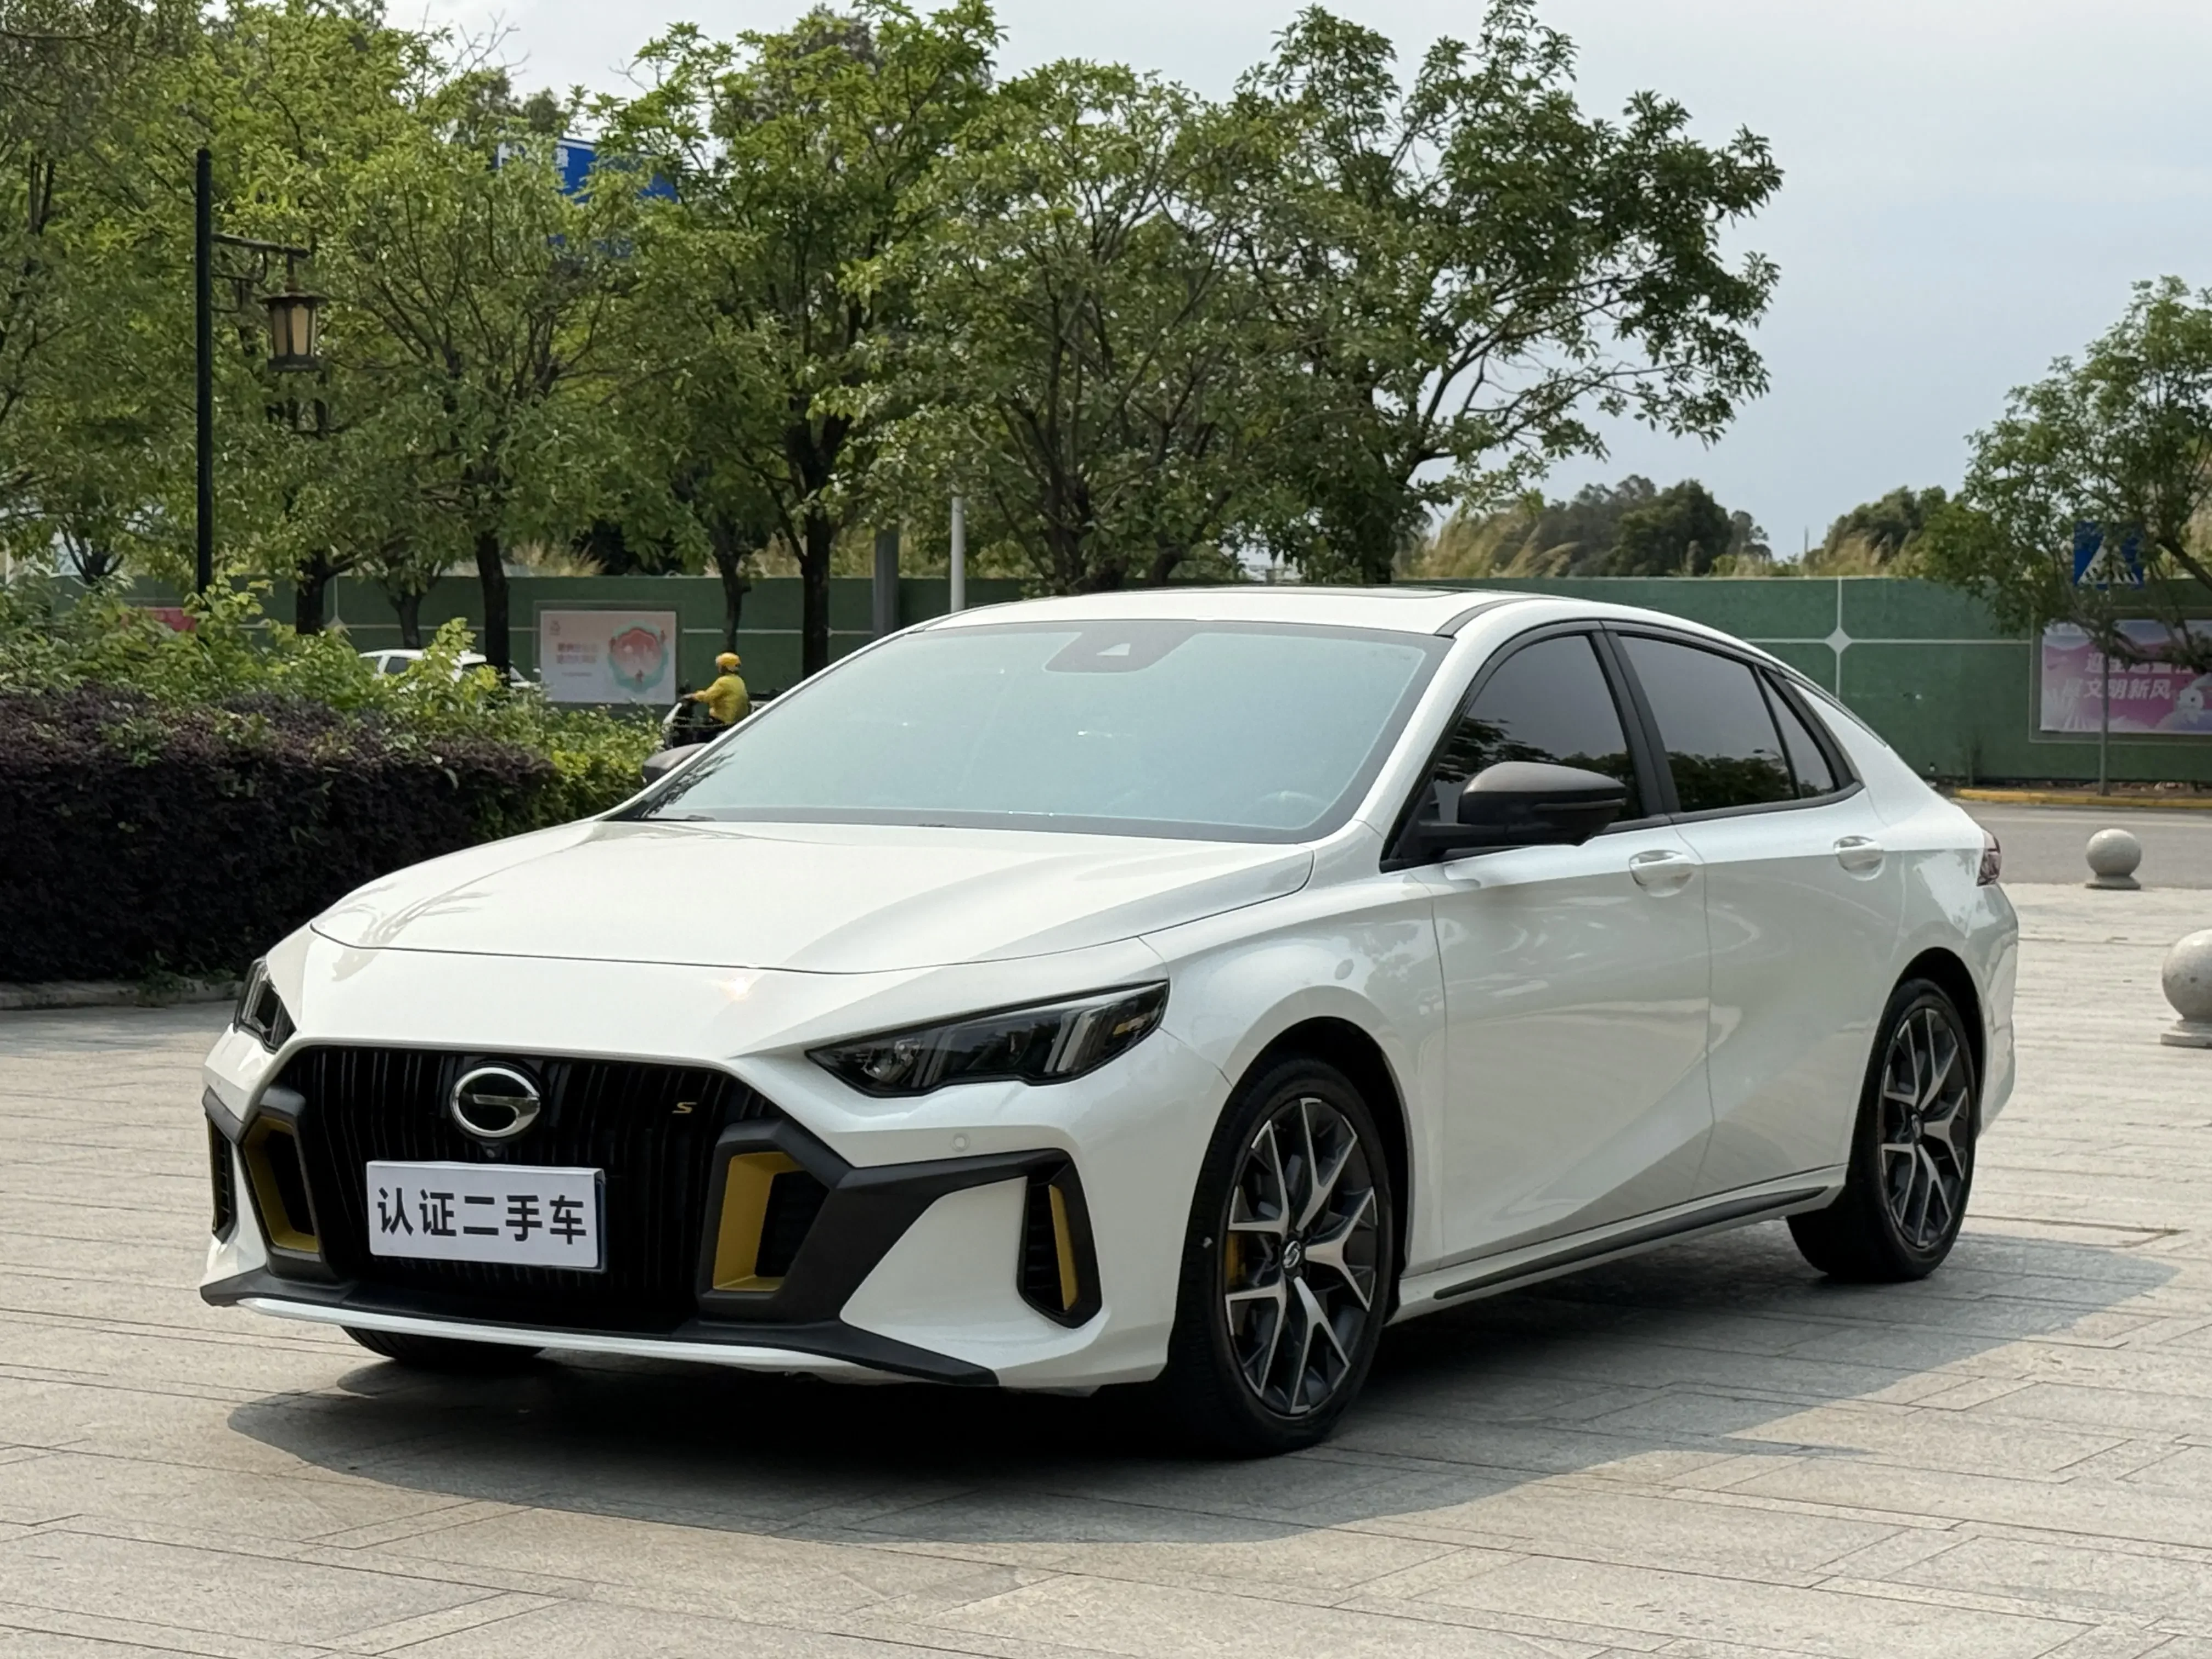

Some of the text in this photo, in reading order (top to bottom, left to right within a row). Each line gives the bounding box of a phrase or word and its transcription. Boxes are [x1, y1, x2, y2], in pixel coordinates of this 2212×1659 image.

[672, 1102, 697, 1114] S
[377, 1187, 587, 1245] 认证二手车
